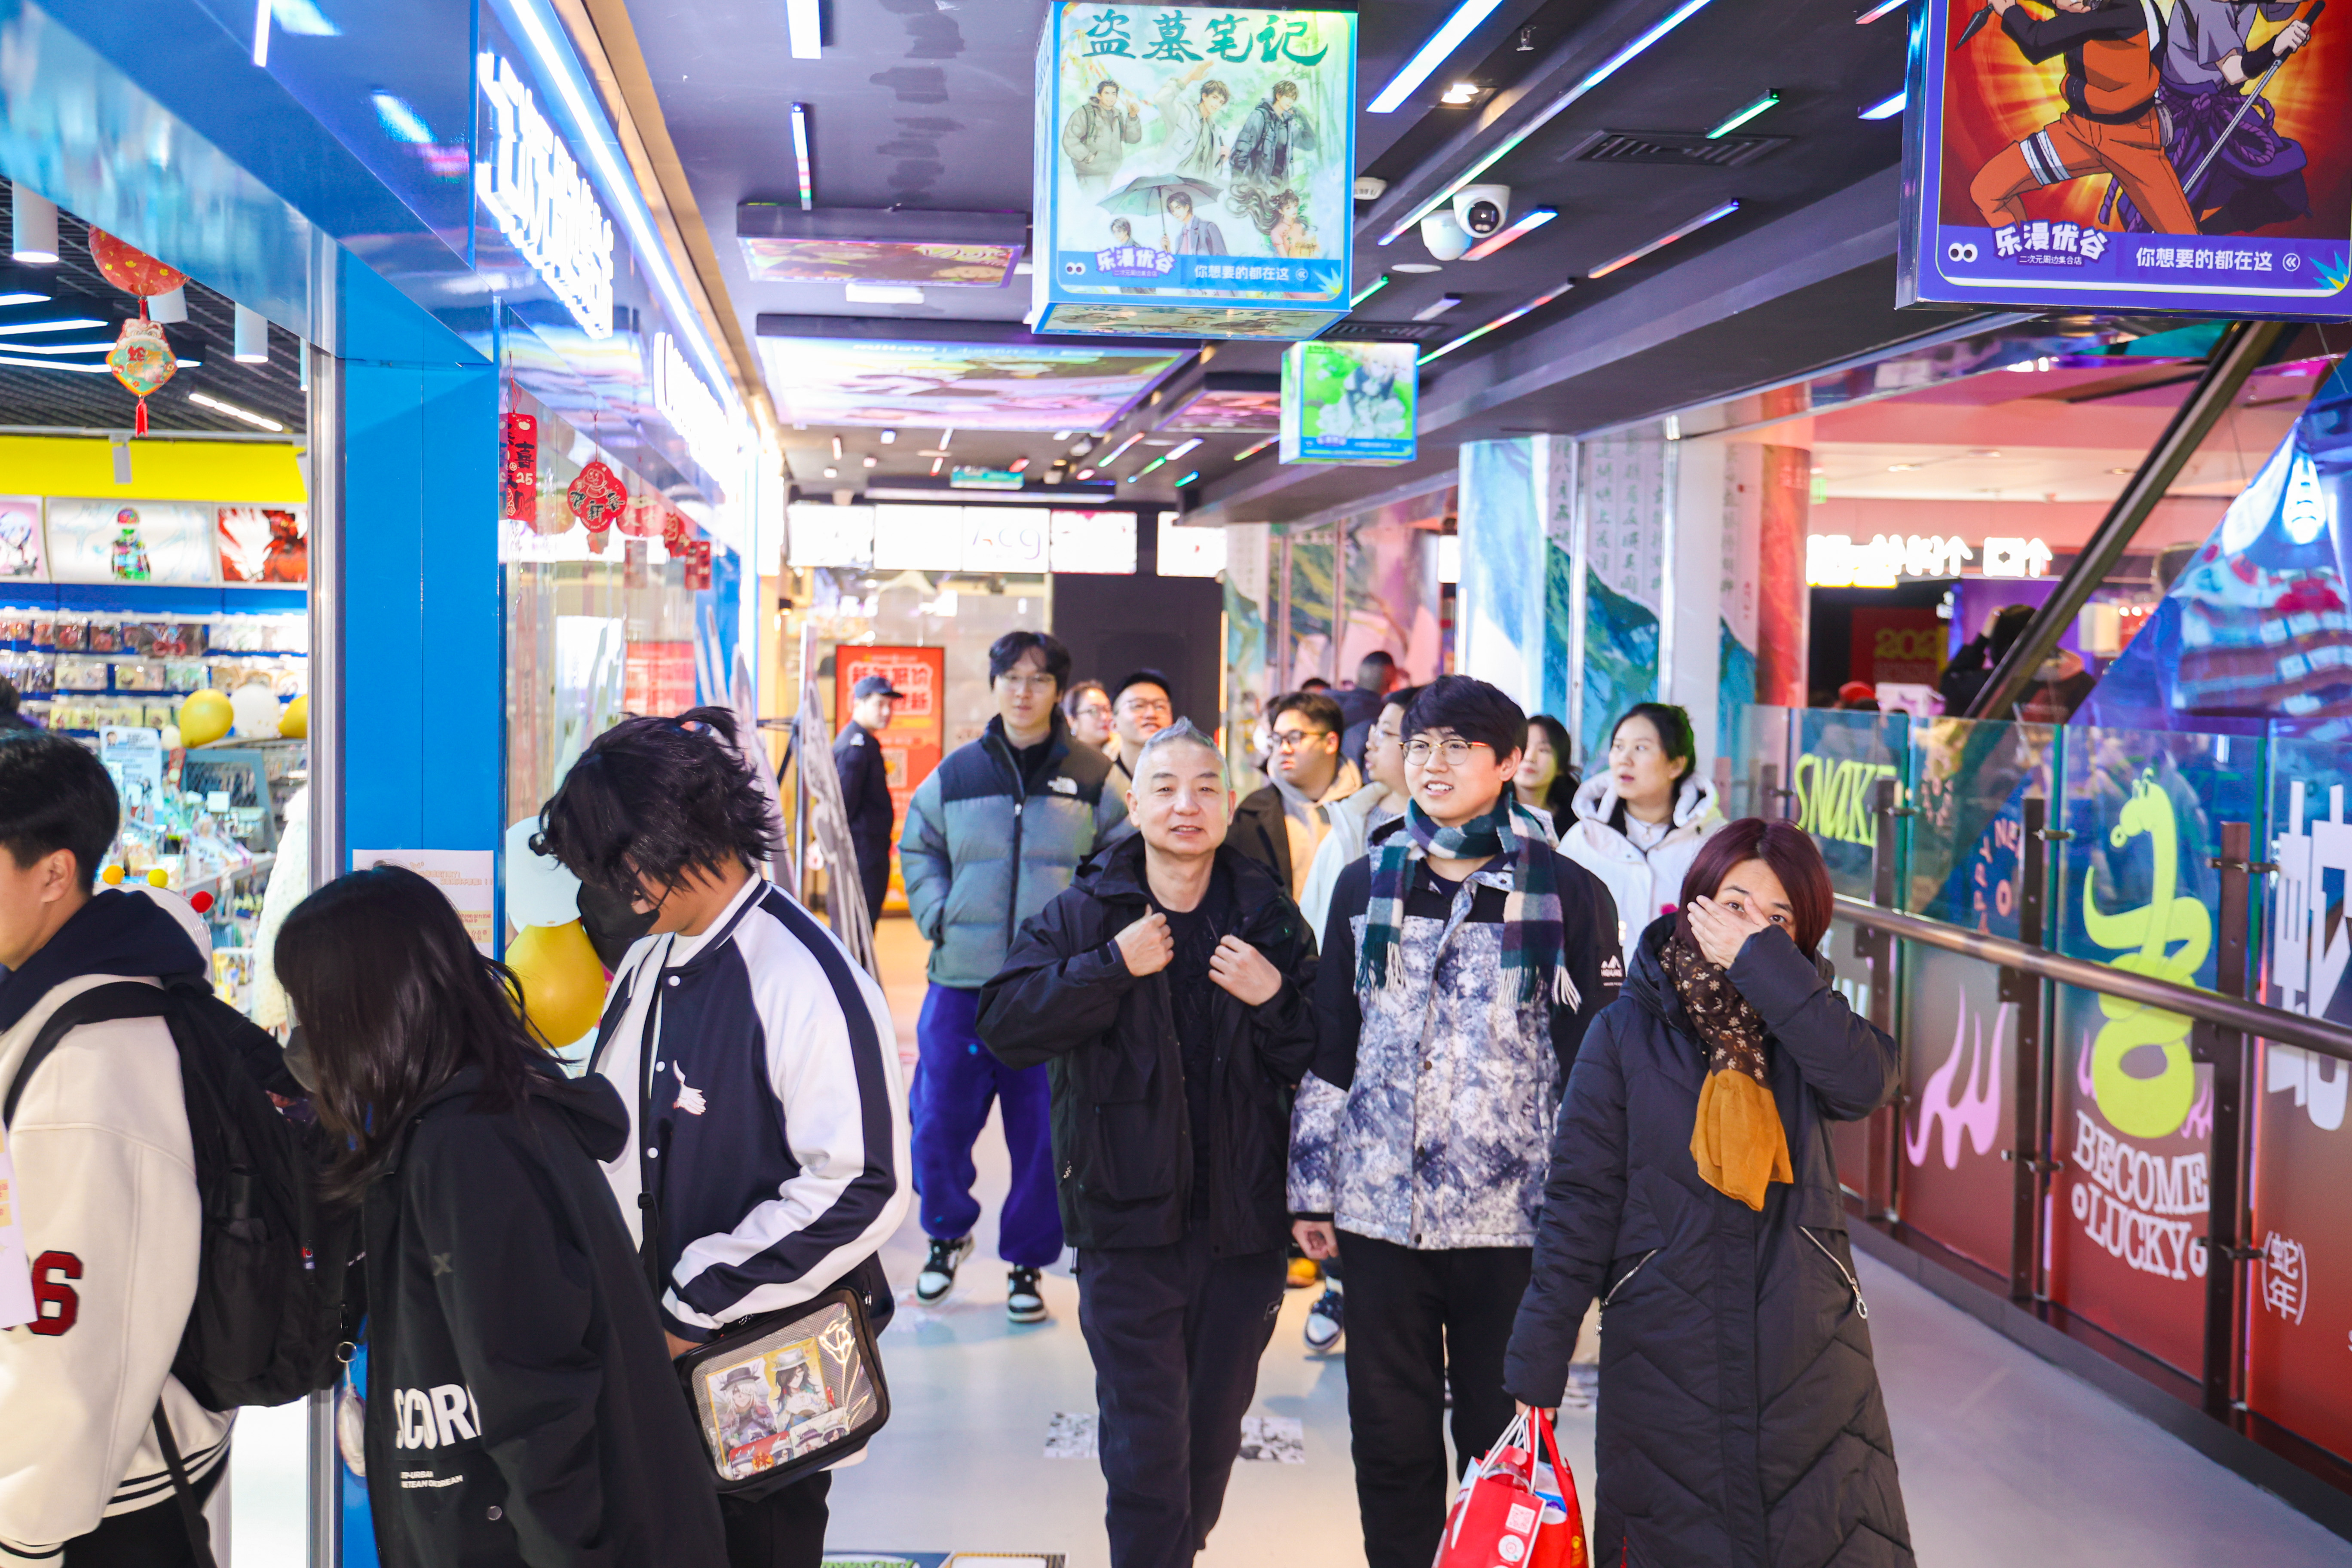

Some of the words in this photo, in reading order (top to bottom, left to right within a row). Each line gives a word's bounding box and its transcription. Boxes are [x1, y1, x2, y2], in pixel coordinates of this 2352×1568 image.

[1082, 9, 1329, 67] 盗墓笔记
[1995, 222, 2108, 260] 乐漫优谷
[2019, 255, 2082, 265] 二次元周边集合店
[2136, 246, 2272, 272] 你想要的都在这
[1097, 248, 1176, 274] 乐漫优谷
[1194, 265, 1289, 281] 你想要的都在这
[2071, 1110, 2209, 1216] BECOME
[2085, 1183, 2192, 1281] LUCKY
[395, 1384, 481, 1449] SCOR
